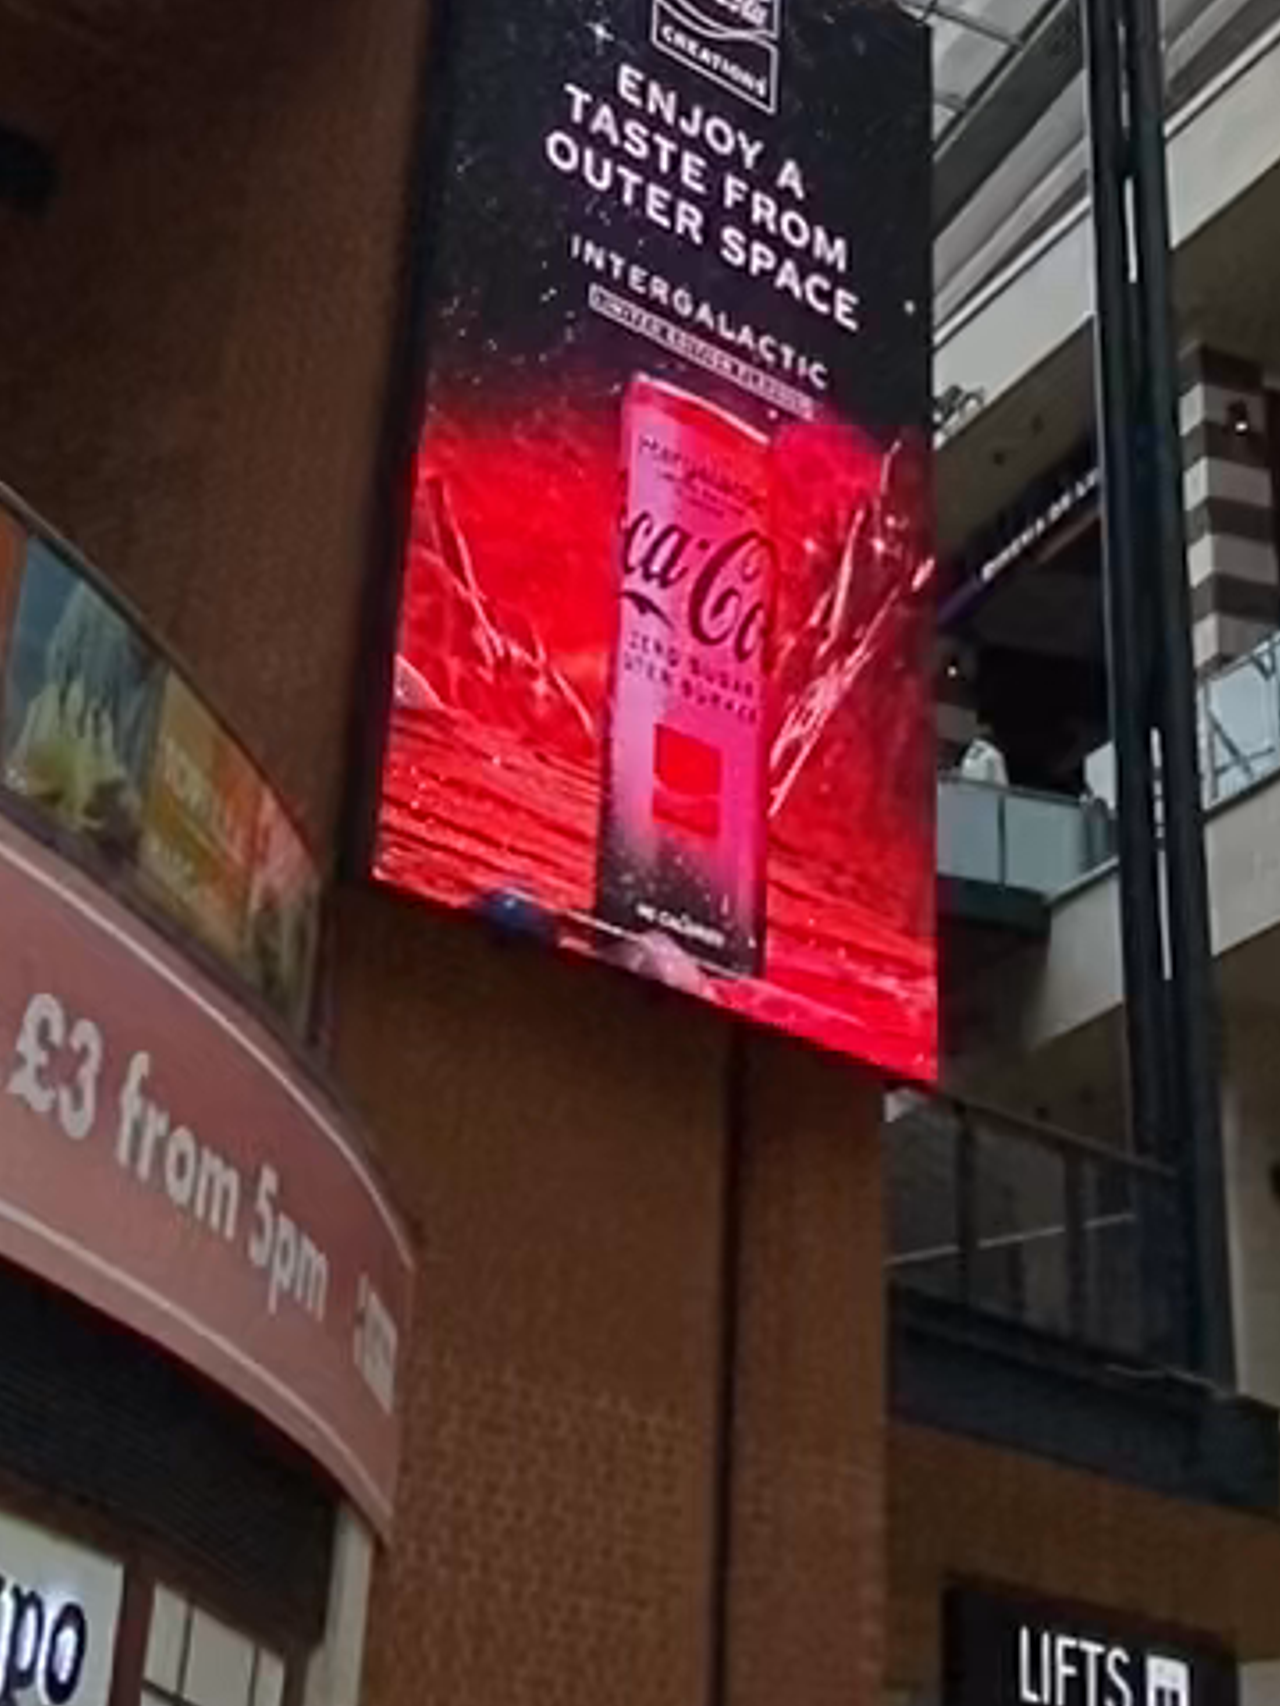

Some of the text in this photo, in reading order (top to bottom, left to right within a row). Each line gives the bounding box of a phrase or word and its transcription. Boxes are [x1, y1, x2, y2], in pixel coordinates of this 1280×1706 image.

[563, 83, 848, 273] TASTE FROM
[619, 62, 805, 200] ENJOY A
[545, 130, 860, 332] OUTER SPACE
[571, 234, 829, 390] INTERGALACTIC
[7, 993, 104, 1142] £3
[118, 1050, 241, 1242] from
[249, 1166, 331, 1324] 5pm
